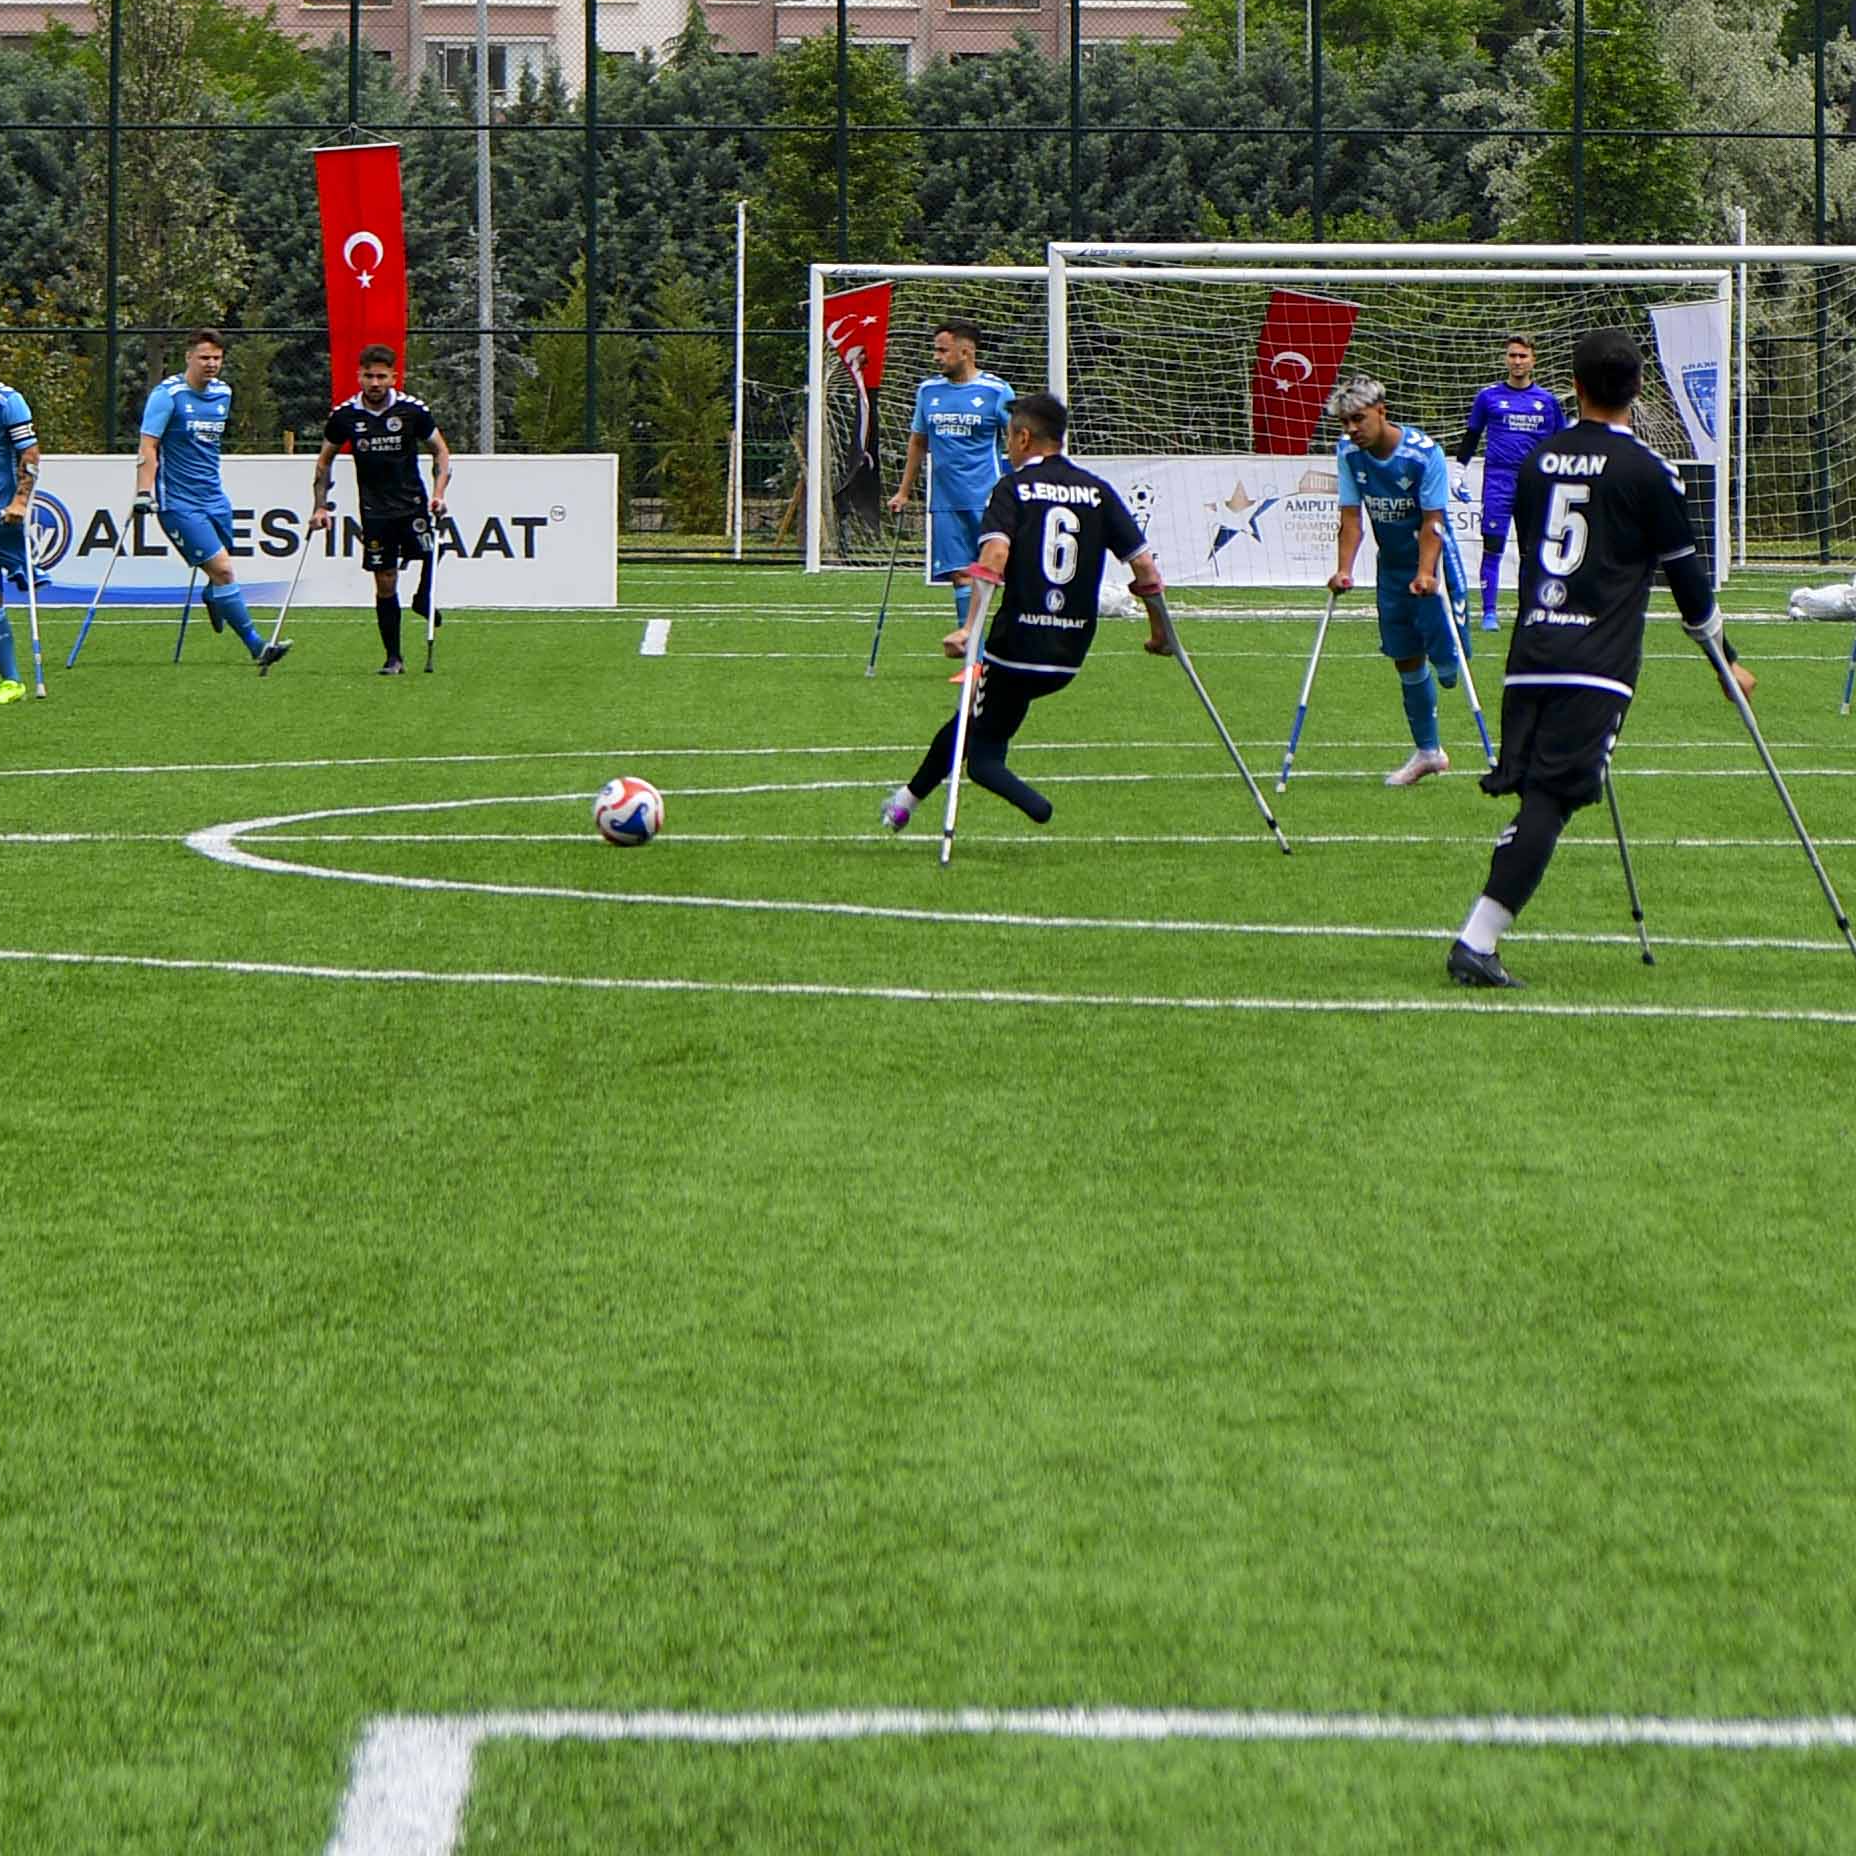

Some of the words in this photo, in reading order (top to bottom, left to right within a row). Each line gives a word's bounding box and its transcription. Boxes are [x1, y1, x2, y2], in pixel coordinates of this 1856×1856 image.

[1540, 452, 1608, 476] OKAN
[1285, 500, 1337, 512] AMPUT
[76, 508, 302, 558] ALES
[1284, 521, 1340, 531] CHAMPIO
[1295, 532, 1336, 542] LEAGU
[1541, 482, 1591, 576] 5
[1044, 506, 1081, 585] 6
